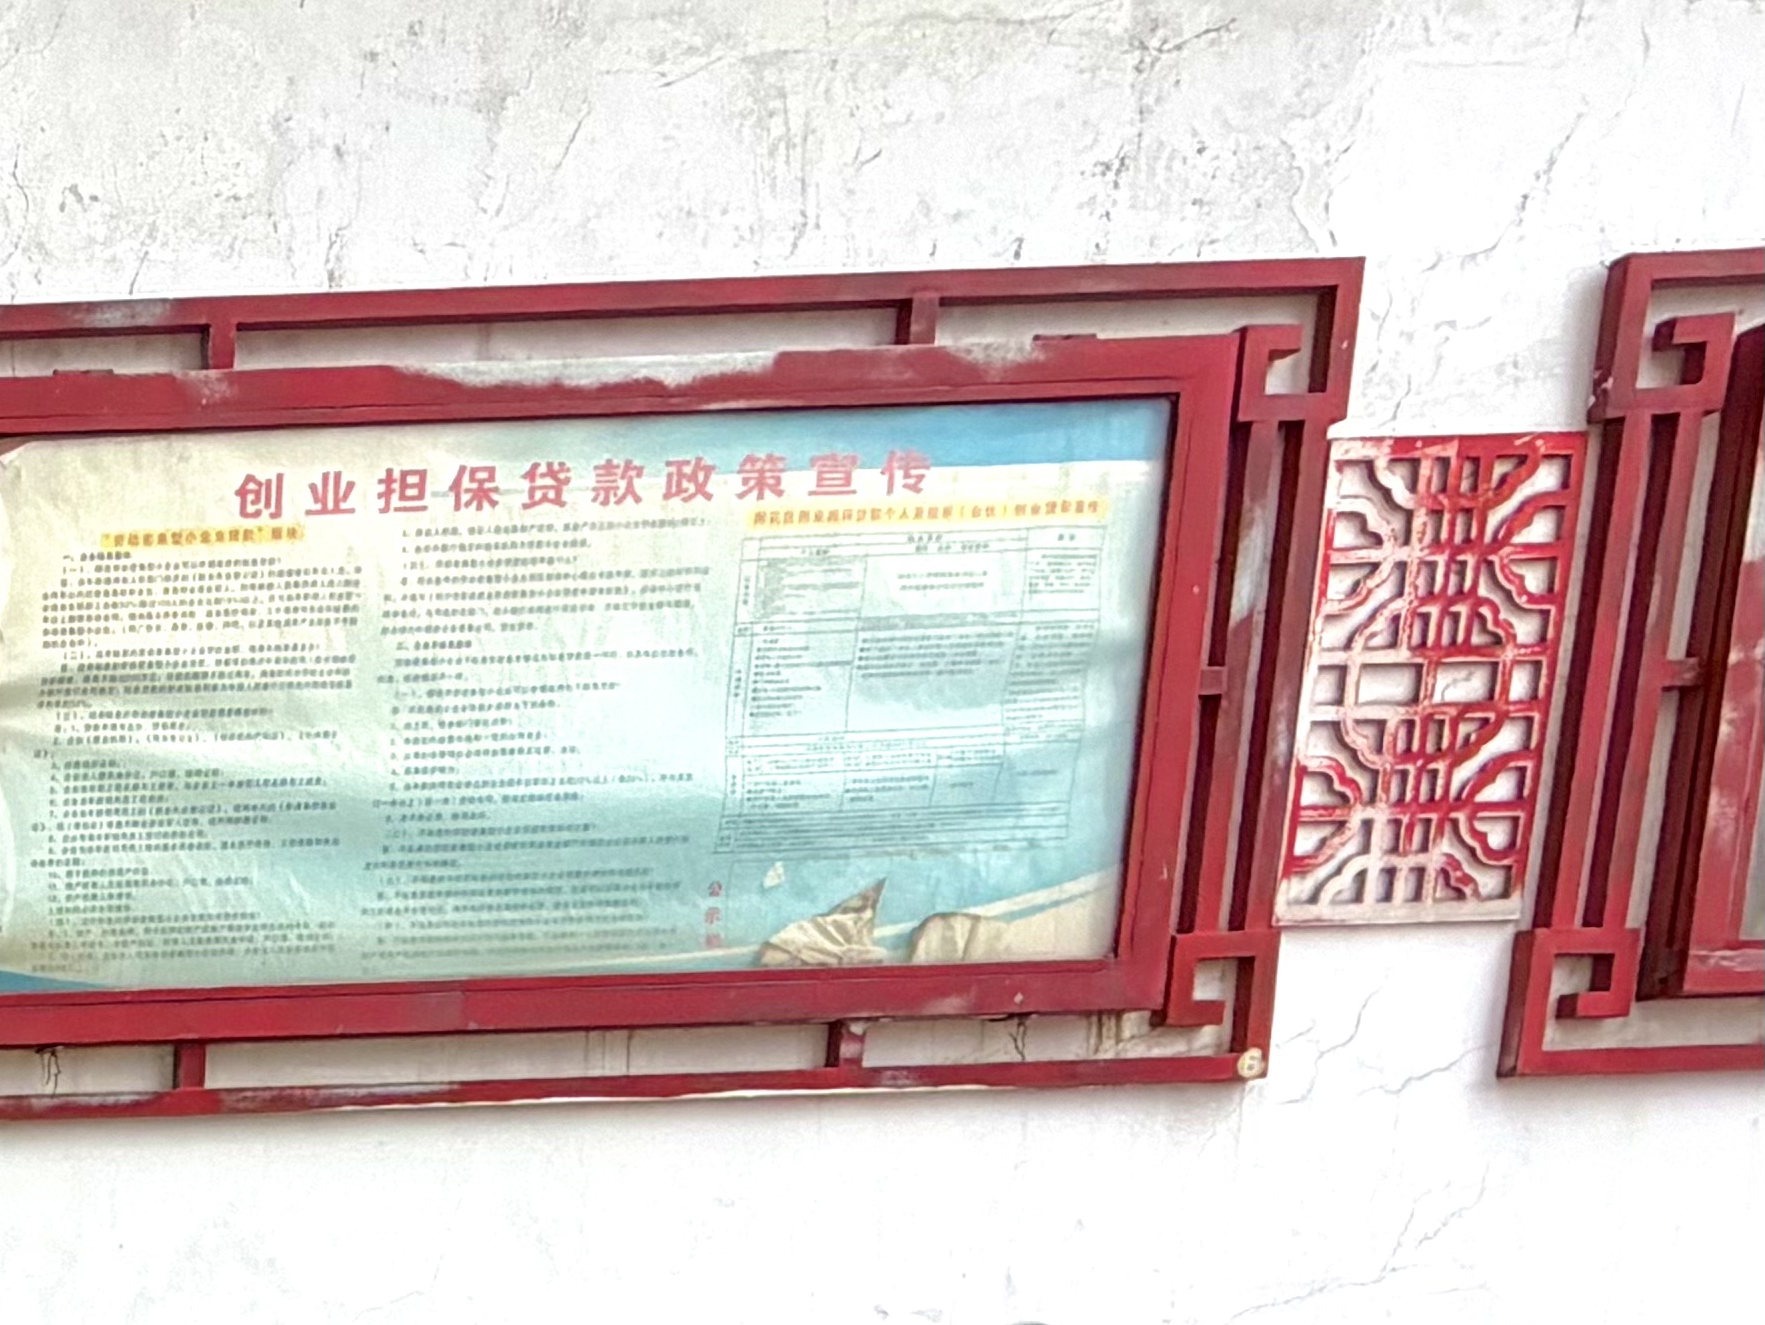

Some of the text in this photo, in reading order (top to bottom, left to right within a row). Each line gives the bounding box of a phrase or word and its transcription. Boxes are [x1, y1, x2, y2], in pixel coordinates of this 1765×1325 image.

[233, 447, 932, 520] 创业担保贷款政策宣传
